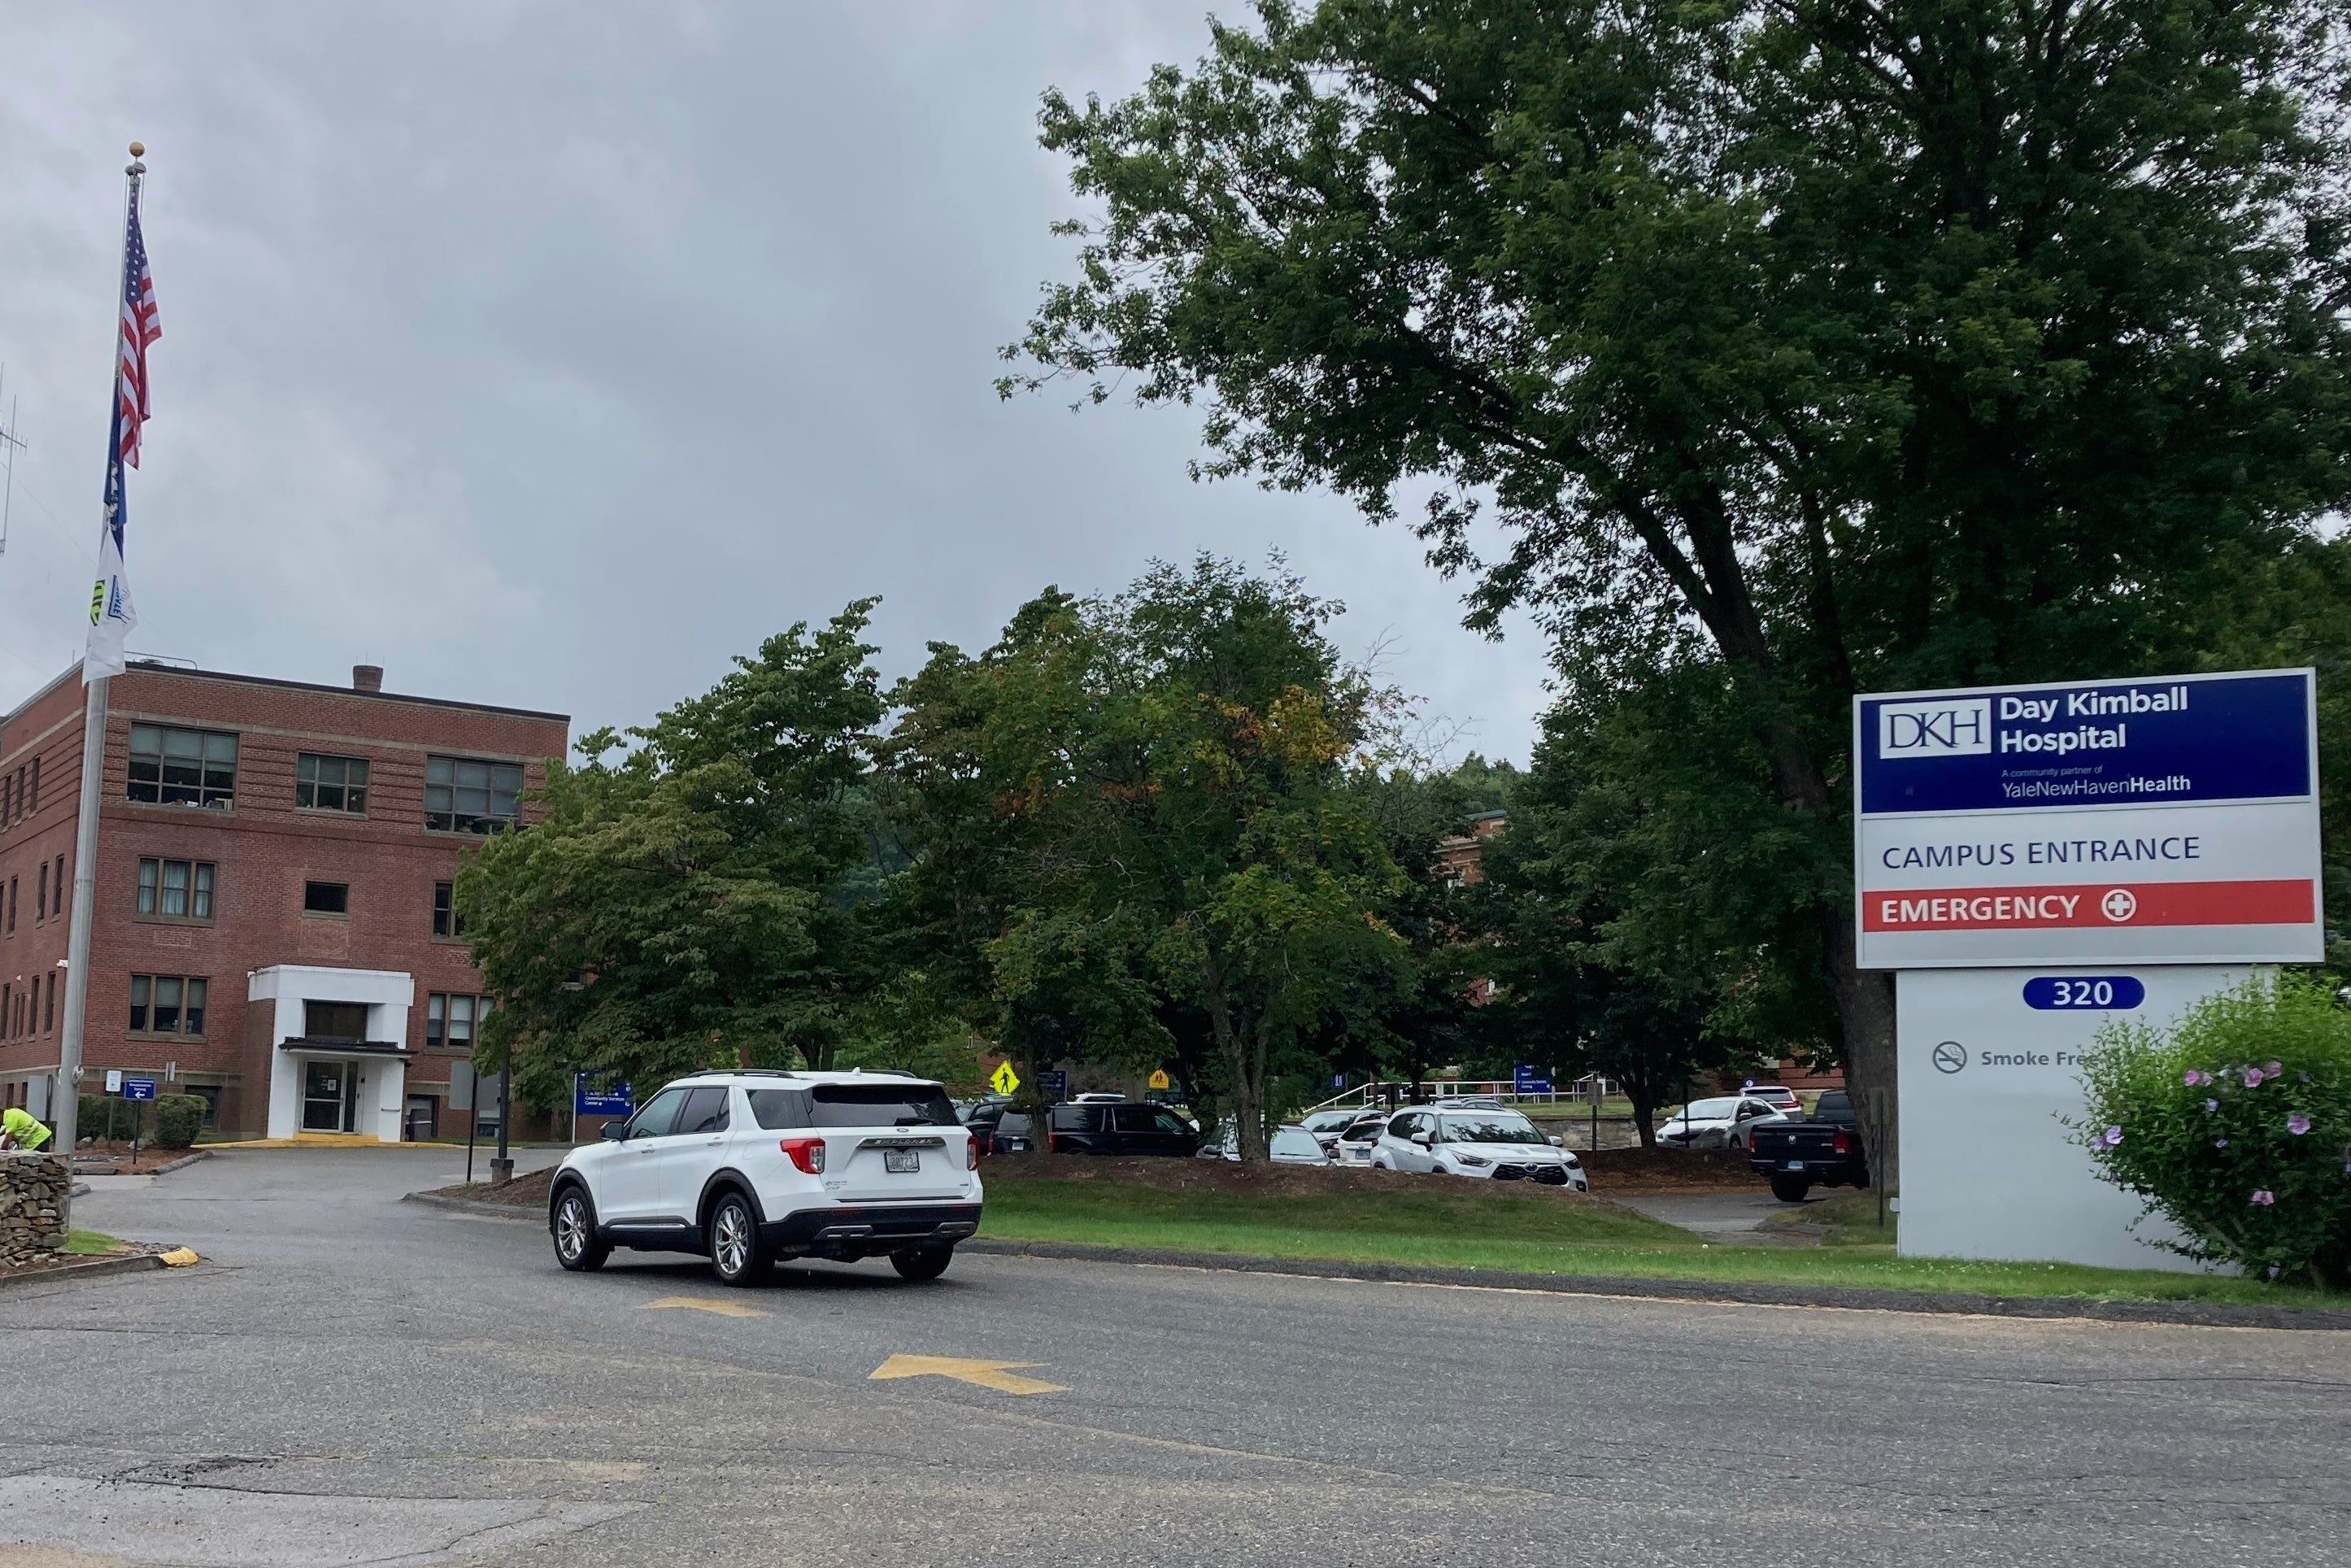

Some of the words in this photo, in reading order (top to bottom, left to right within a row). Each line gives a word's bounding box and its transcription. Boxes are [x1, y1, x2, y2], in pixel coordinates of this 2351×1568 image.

[2000, 697, 2059, 722] Day
[2068, 686, 2188, 716] Kimball
[1887, 709, 1984, 749] DKH
[2001, 723, 2127, 756] Hospital
[2002, 769, 2009, 777] A
[2009, 767, 2059, 777] community
[2060, 766, 2092, 775] partner
[2093, 764, 2103, 774] of
[2002, 776, 2191, 797] YaleNewHavenHealth
[1883, 843, 2015, 869] CAMPUS
[2028, 836, 2201, 864] ENTRANCE
[1881, 895, 2080, 924] EMERGENCY
[2053, 982, 2113, 1005] 320
[1981, 1051, 2050, 1066] Smoke
